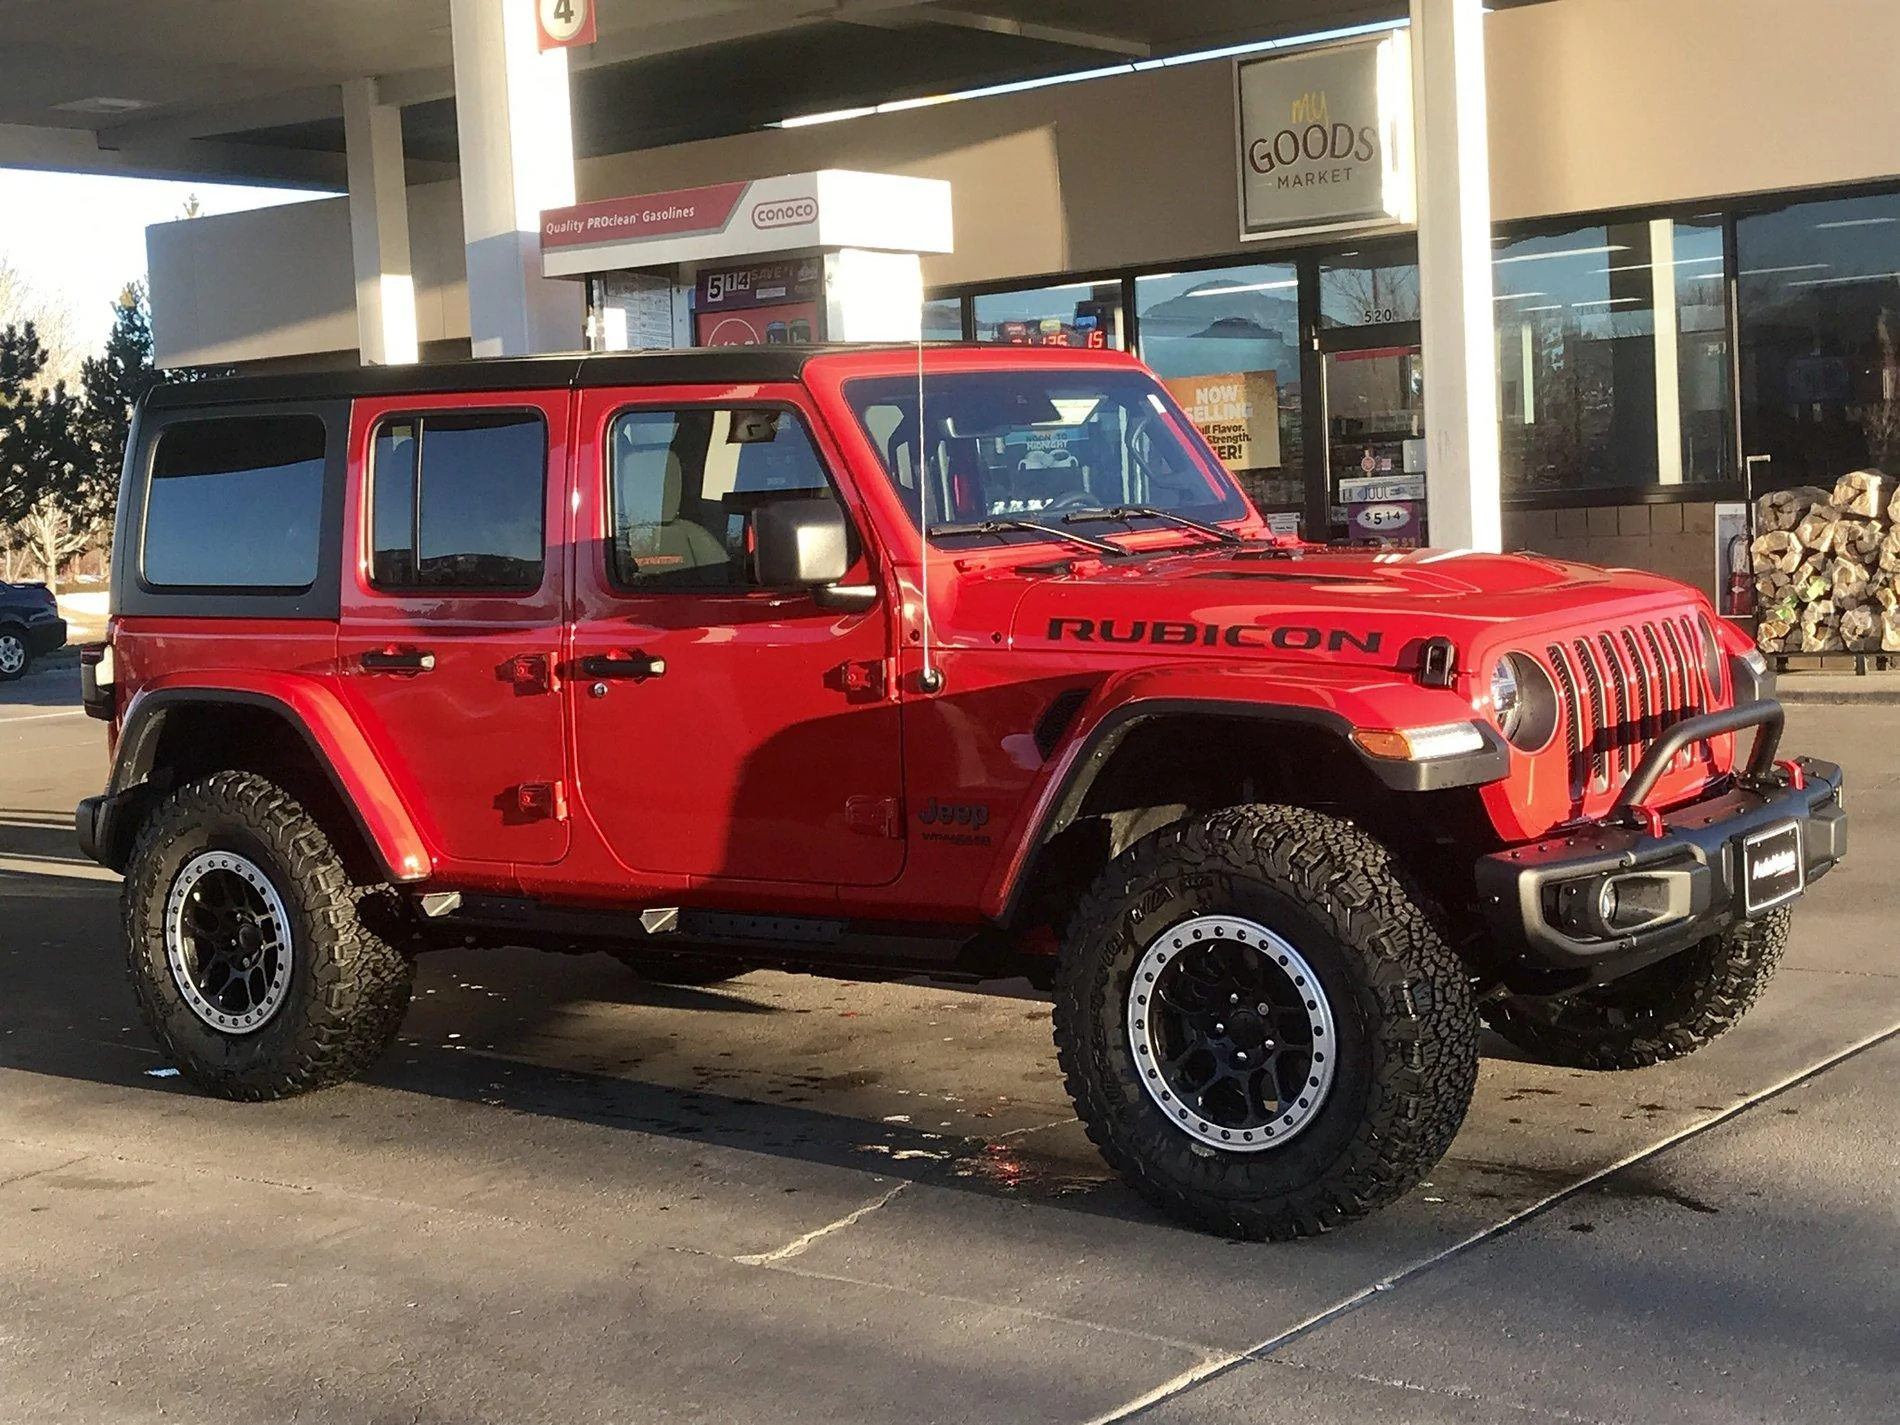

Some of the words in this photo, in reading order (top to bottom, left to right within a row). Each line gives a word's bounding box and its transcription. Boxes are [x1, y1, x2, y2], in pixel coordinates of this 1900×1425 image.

[553, 0, 574, 24] 4
[1249, 123, 1377, 174] GOODS
[1277, 167, 1352, 189] MARKET
[546, 220, 584, 235] Quality
[642, 206, 695, 222] Gasolines
[1365, 309, 1392, 323] 520
[1196, 385, 1239, 405] NOW
[1184, 402, 1254, 423] SELLING
[1206, 433, 1252, 445] Strength.
[1212, 424, 1245, 434] Flavor.
[1048, 617, 1384, 654] RUBICON
[919, 797, 989, 831] Jeep
